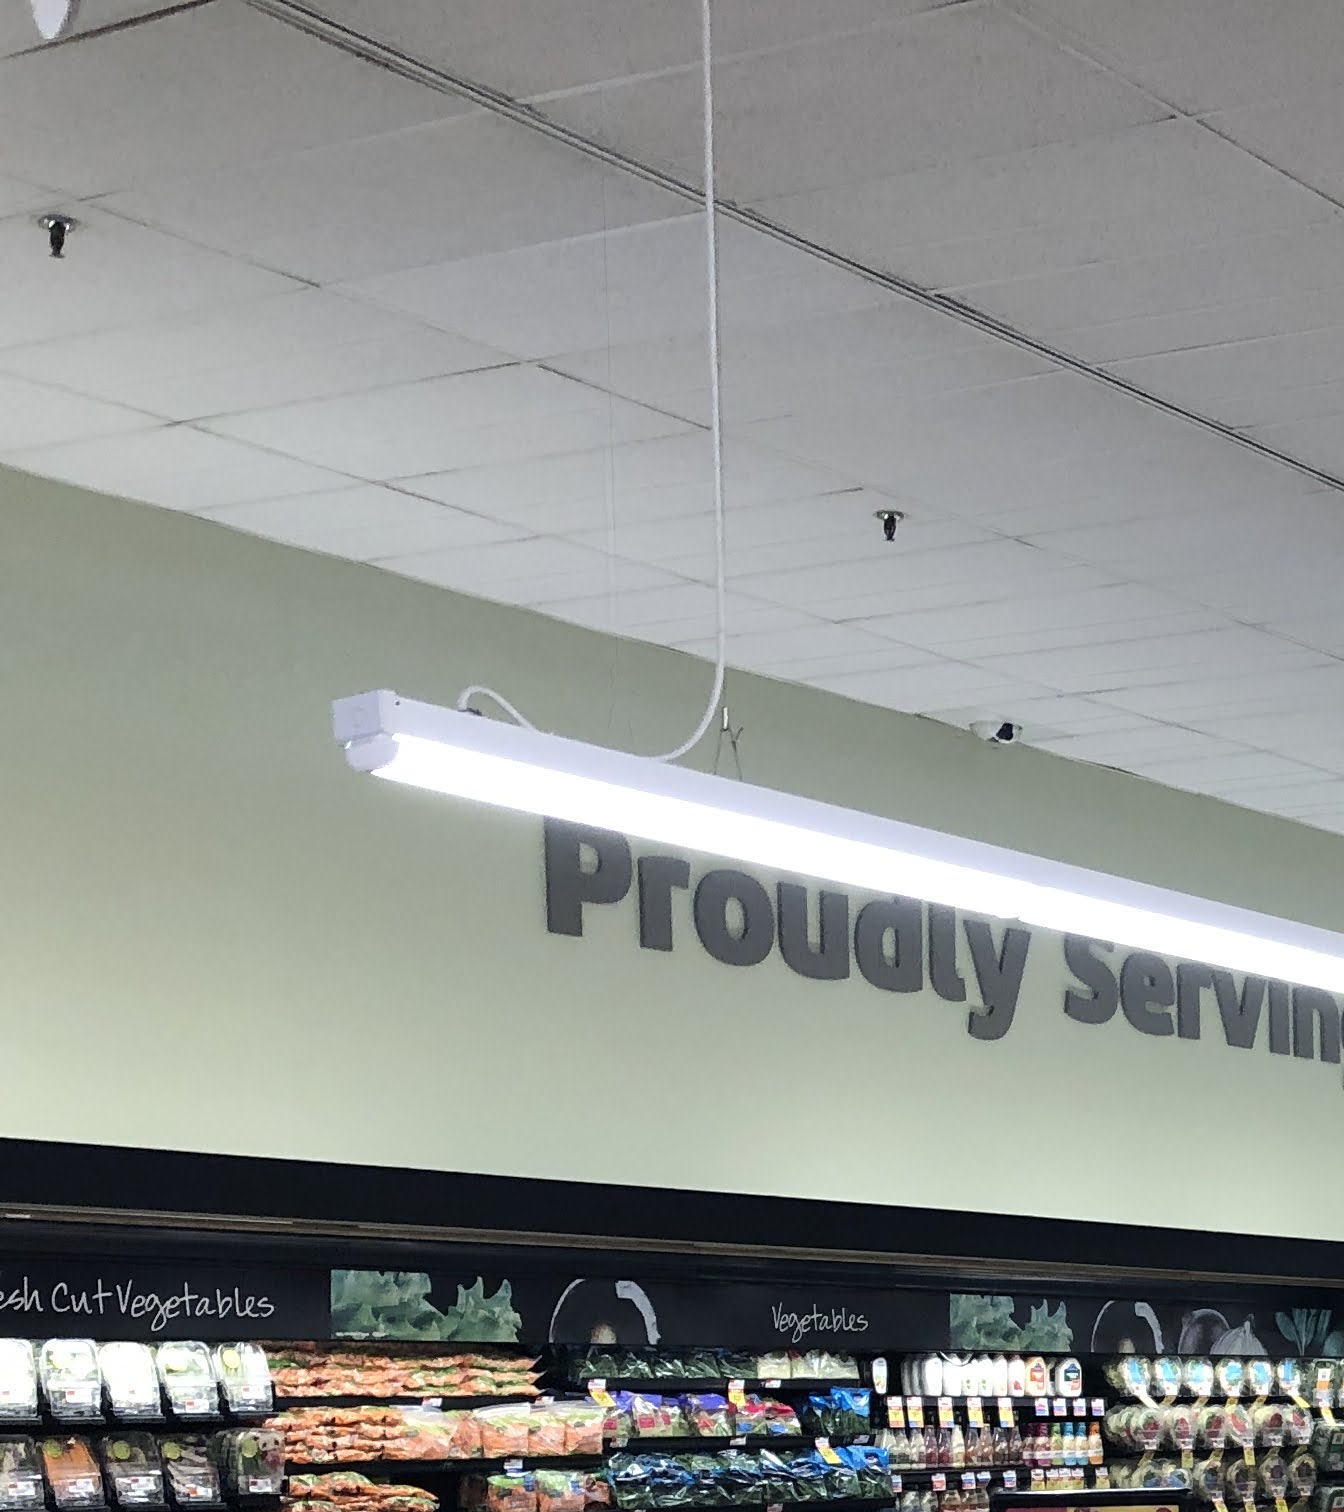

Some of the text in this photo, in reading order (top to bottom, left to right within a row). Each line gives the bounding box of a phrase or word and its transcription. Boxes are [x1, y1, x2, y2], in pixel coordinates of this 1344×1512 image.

[544, 815, 1031, 1040] Proudly
[51, 1278, 112, 1314] Cut
[116, 1279, 275, 1331] Vegetables
[772, 1302, 869, 1344] Vegetables
